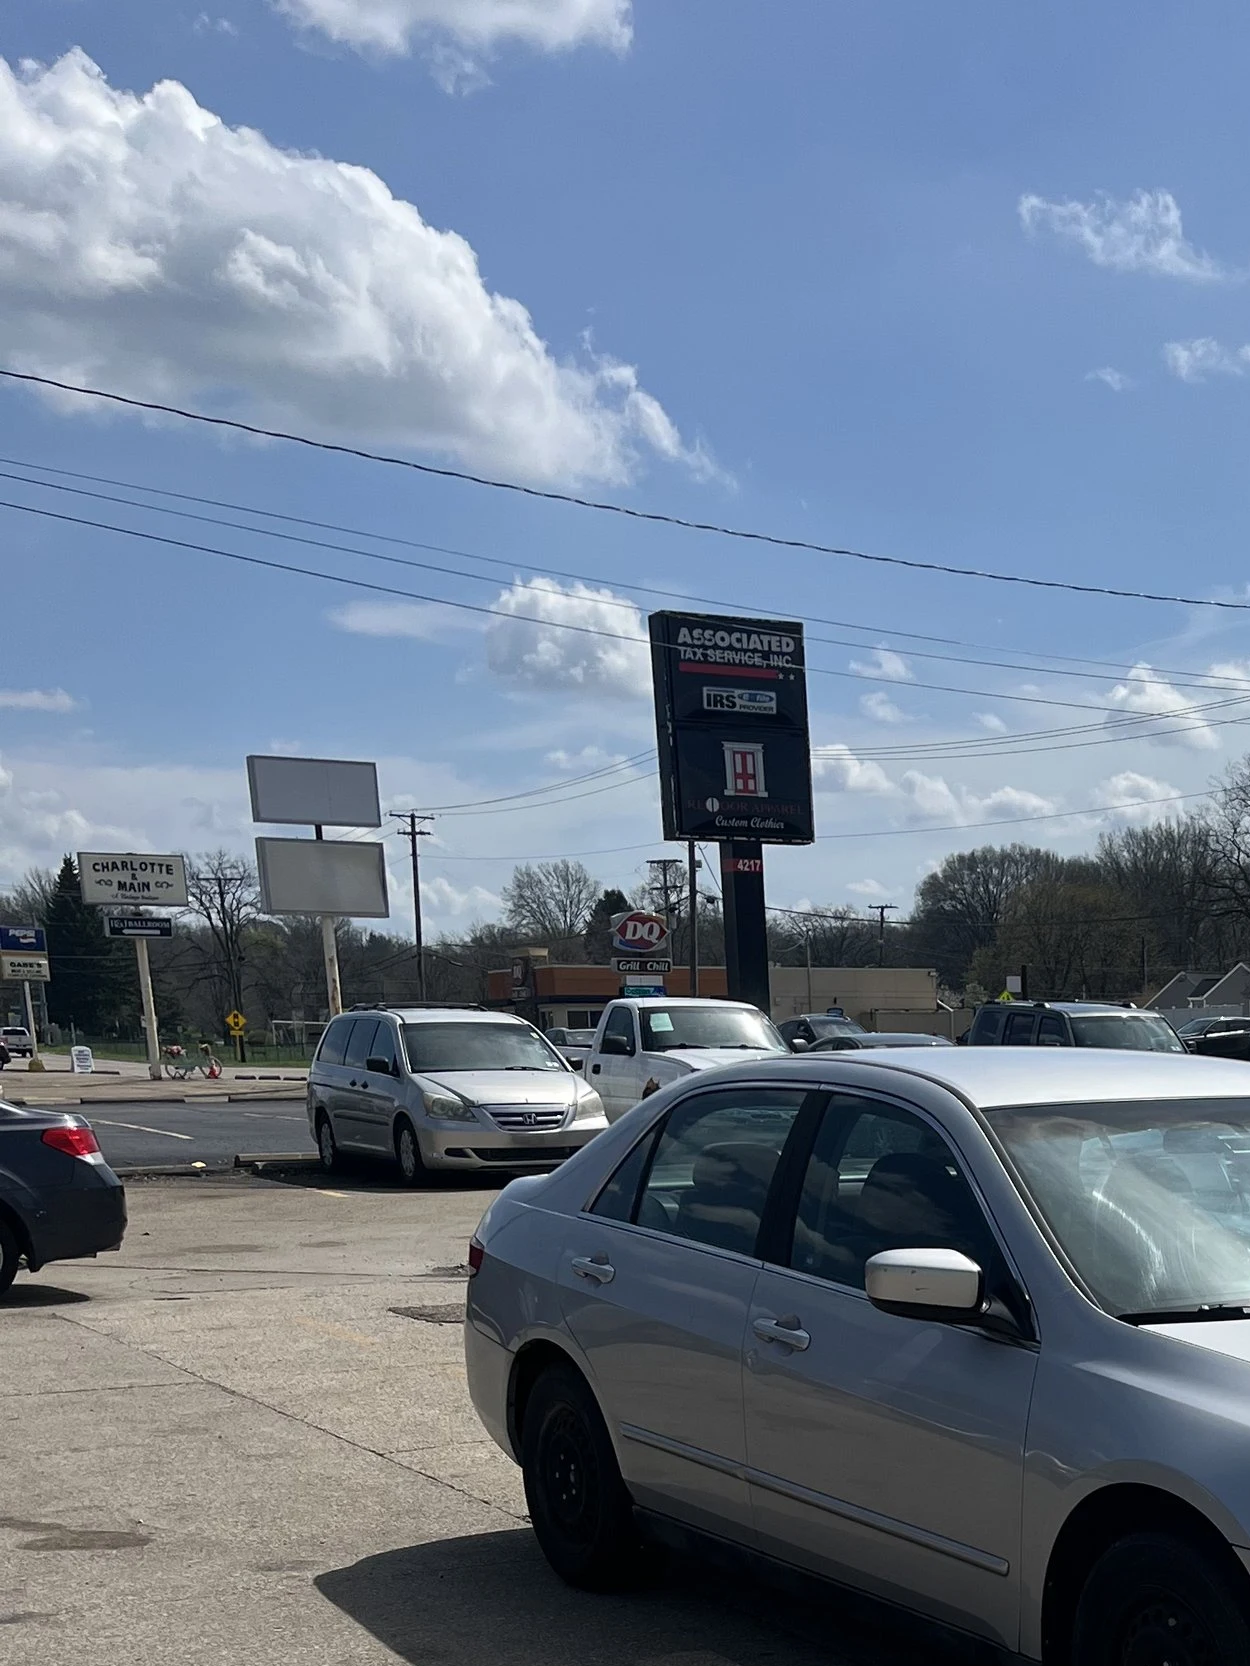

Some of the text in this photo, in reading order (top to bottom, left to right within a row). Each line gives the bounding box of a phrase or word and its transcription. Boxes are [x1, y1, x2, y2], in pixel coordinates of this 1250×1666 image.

[678, 627, 795, 653] ASSOCIATED
[679, 647, 705, 661] TAX
[706, 693, 737, 709] IRS
[715, 815, 748, 828] Custom
[92, 860, 174, 876] CHARLOTTE
[737, 860, 761, 872] 4217
[117, 881, 151, 893] MAIN
[128, 920, 170, 930] BALLROOM
[625, 920, 661, 943] DQ
[619, 961, 669, 971] Grill Chill
